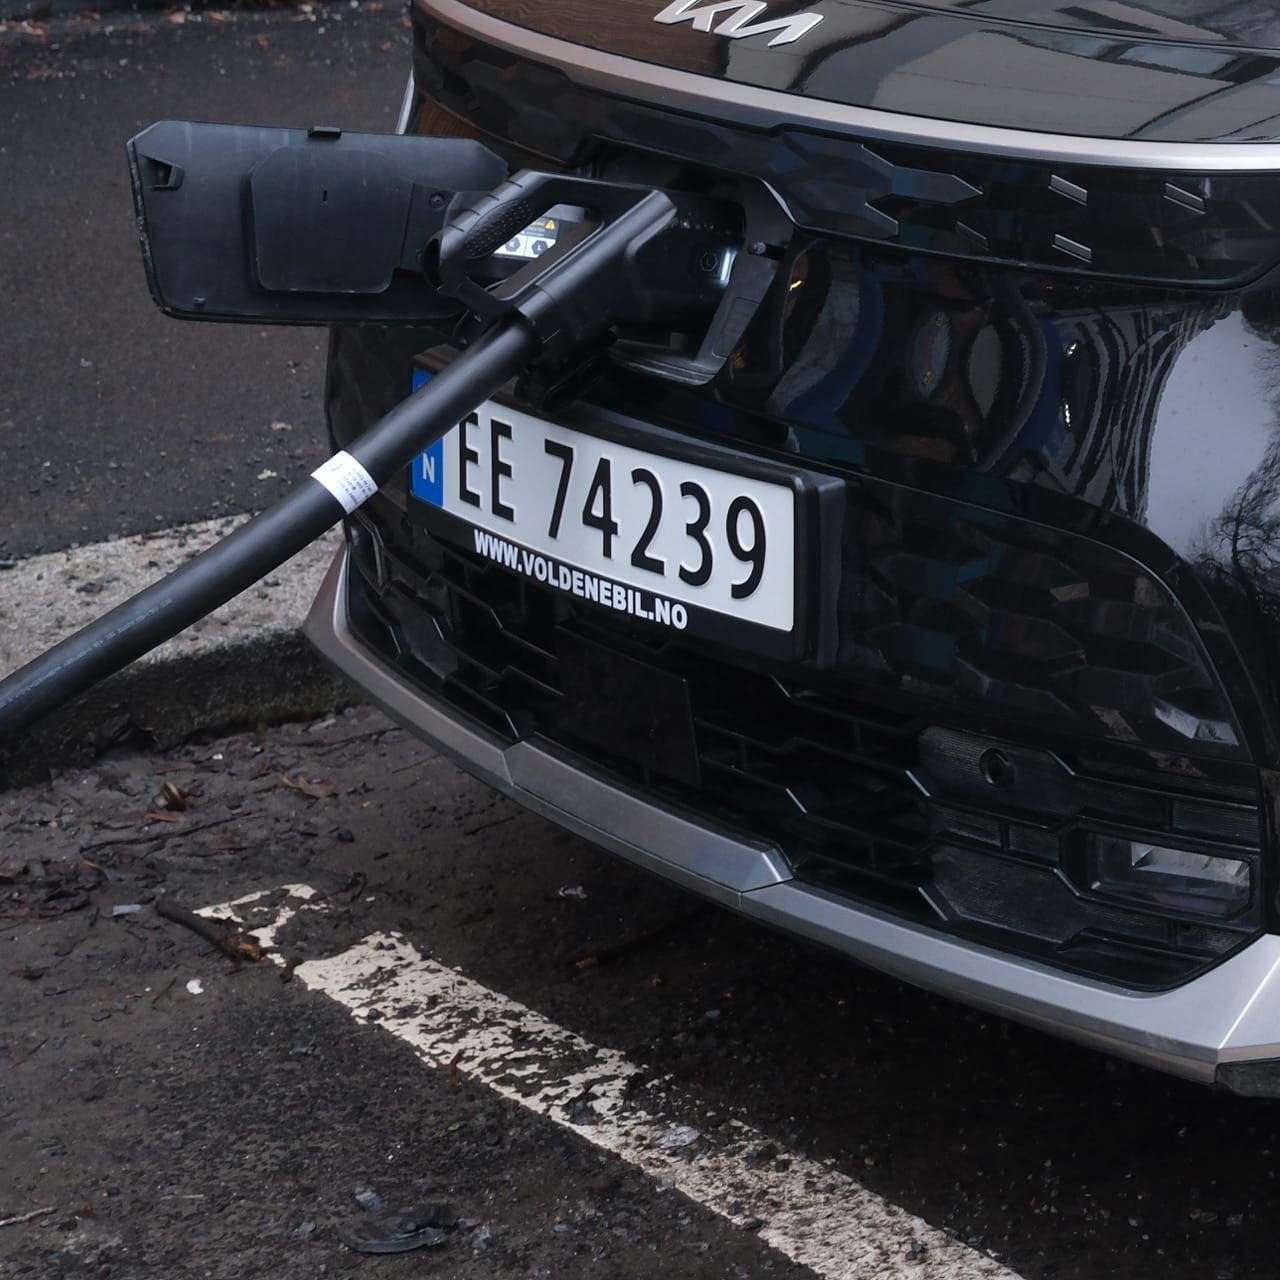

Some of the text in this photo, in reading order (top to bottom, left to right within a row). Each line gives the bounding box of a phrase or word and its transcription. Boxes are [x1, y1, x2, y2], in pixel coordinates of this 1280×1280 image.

[422, 452, 436, 484] N
[459, 412, 767, 600] EE 74239
[473, 528, 689, 631] WWW.VOLDENEBIL.NO
